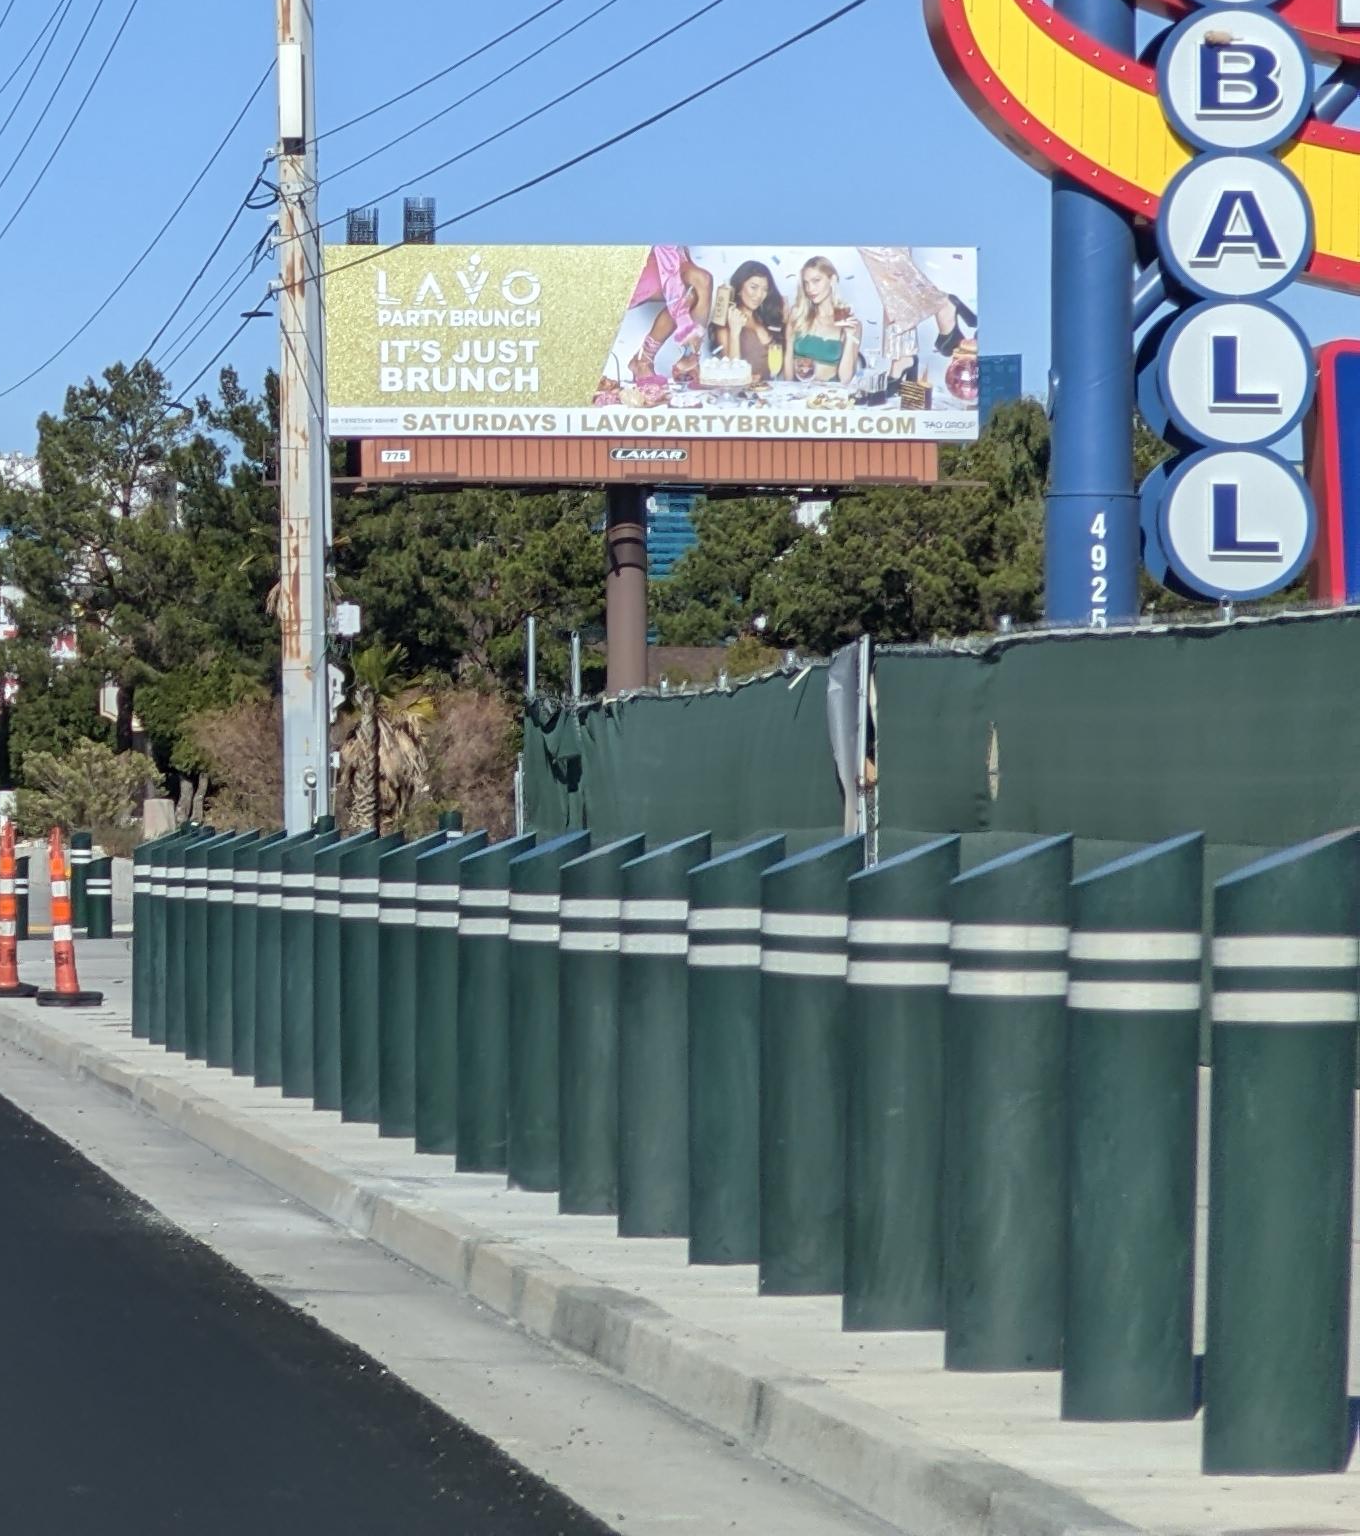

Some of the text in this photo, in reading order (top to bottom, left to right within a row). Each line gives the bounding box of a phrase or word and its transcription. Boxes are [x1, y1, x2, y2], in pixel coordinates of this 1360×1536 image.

[378, 264, 541, 305] LAVO
[379, 310, 541, 326] PARTY BRUNCH
[381, 340, 539, 363] IT'S JUST
[381, 367, 539, 392] BRUNCH
[402, 414, 915, 434] SATURDAYS LAVOPARTYBRUNCH.COM
[385, 452, 406, 460] 775
[615, 450, 682, 461] LAMAR
